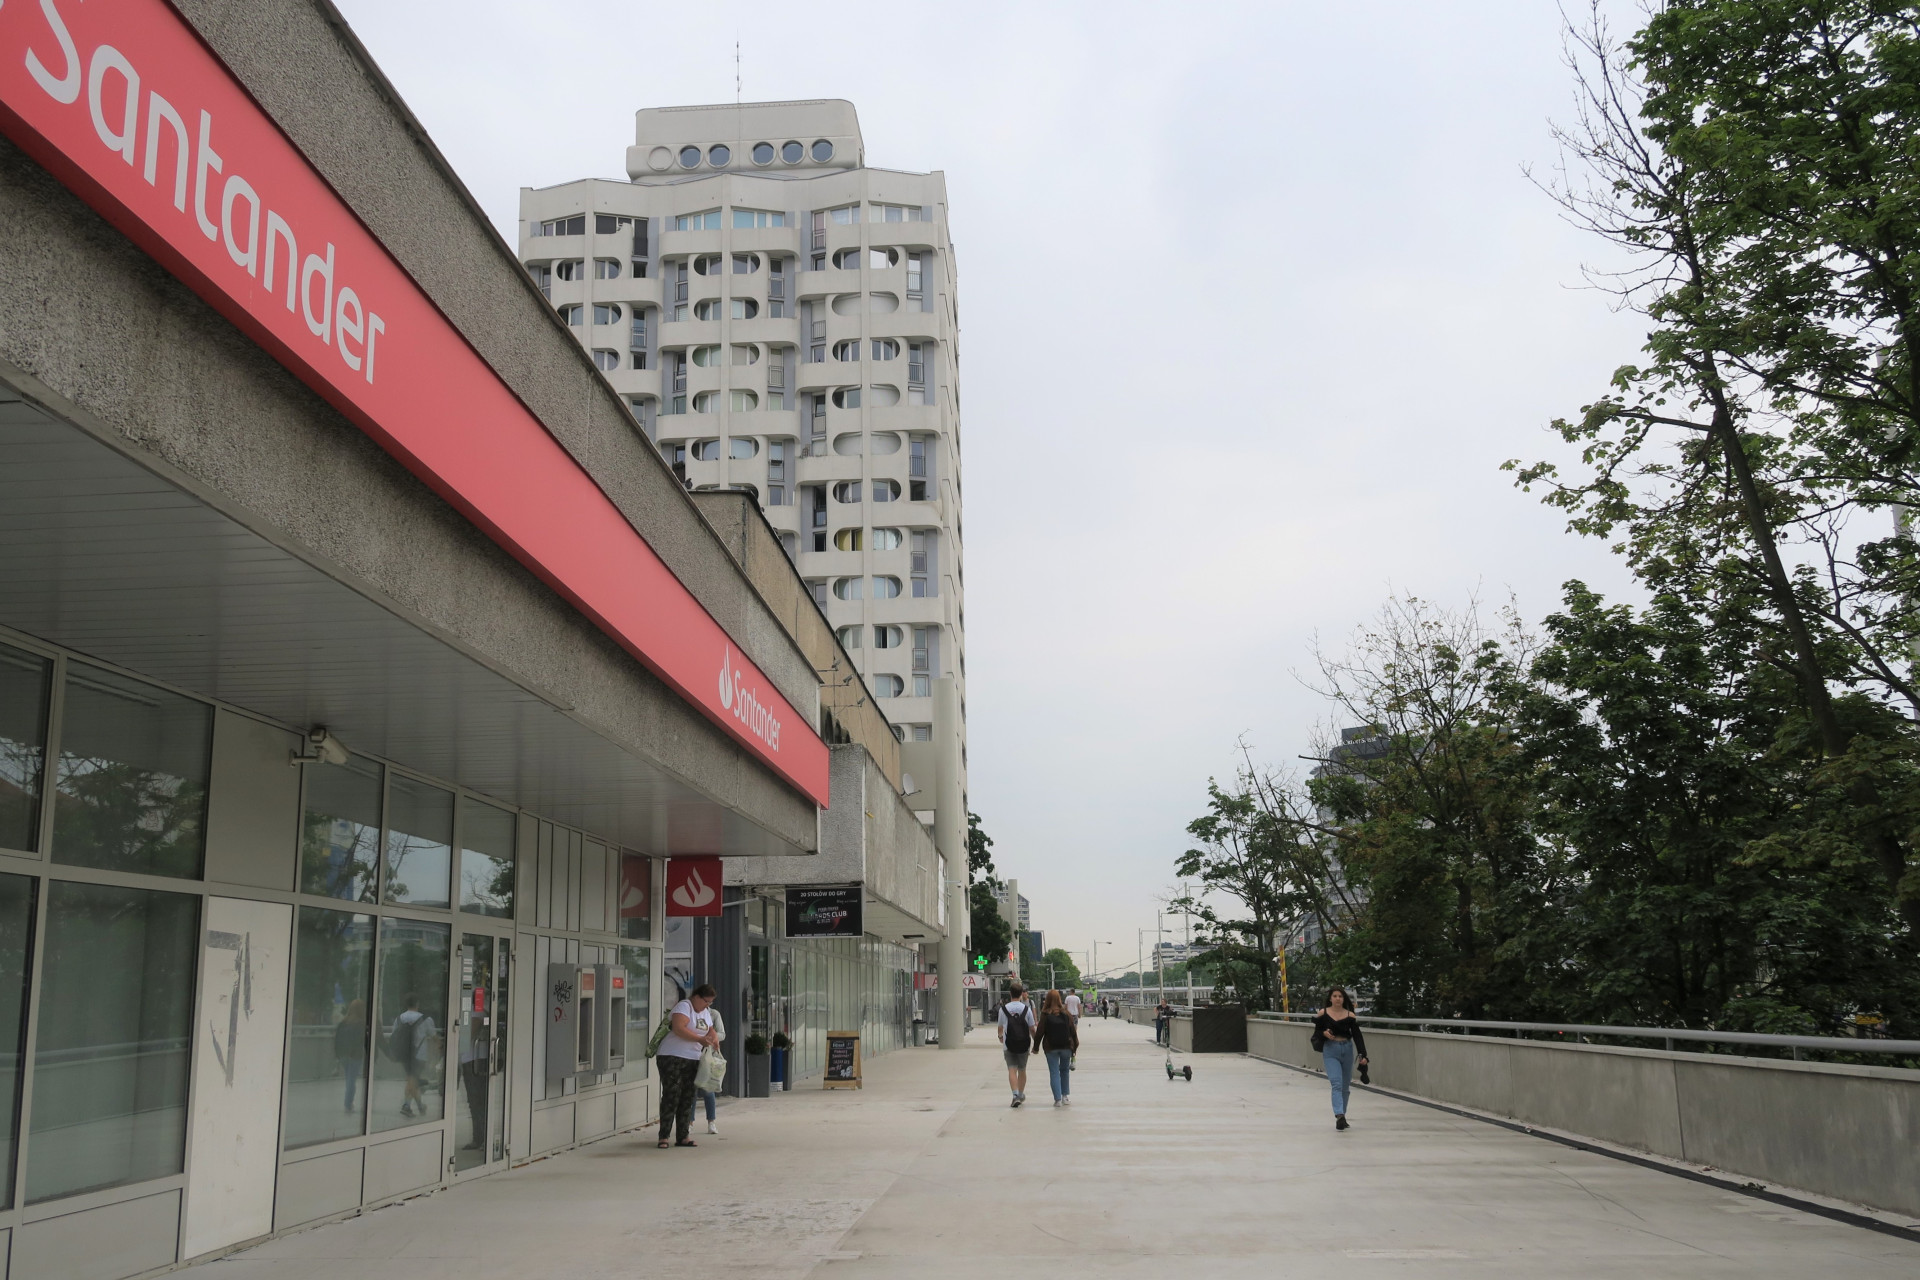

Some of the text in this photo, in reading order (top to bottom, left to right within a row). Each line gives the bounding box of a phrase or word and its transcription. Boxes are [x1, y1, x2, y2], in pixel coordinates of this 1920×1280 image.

[25, 0, 385, 384] Santander
[733, 670, 781, 752] Santander
[831, 910, 847, 918] CLUB
